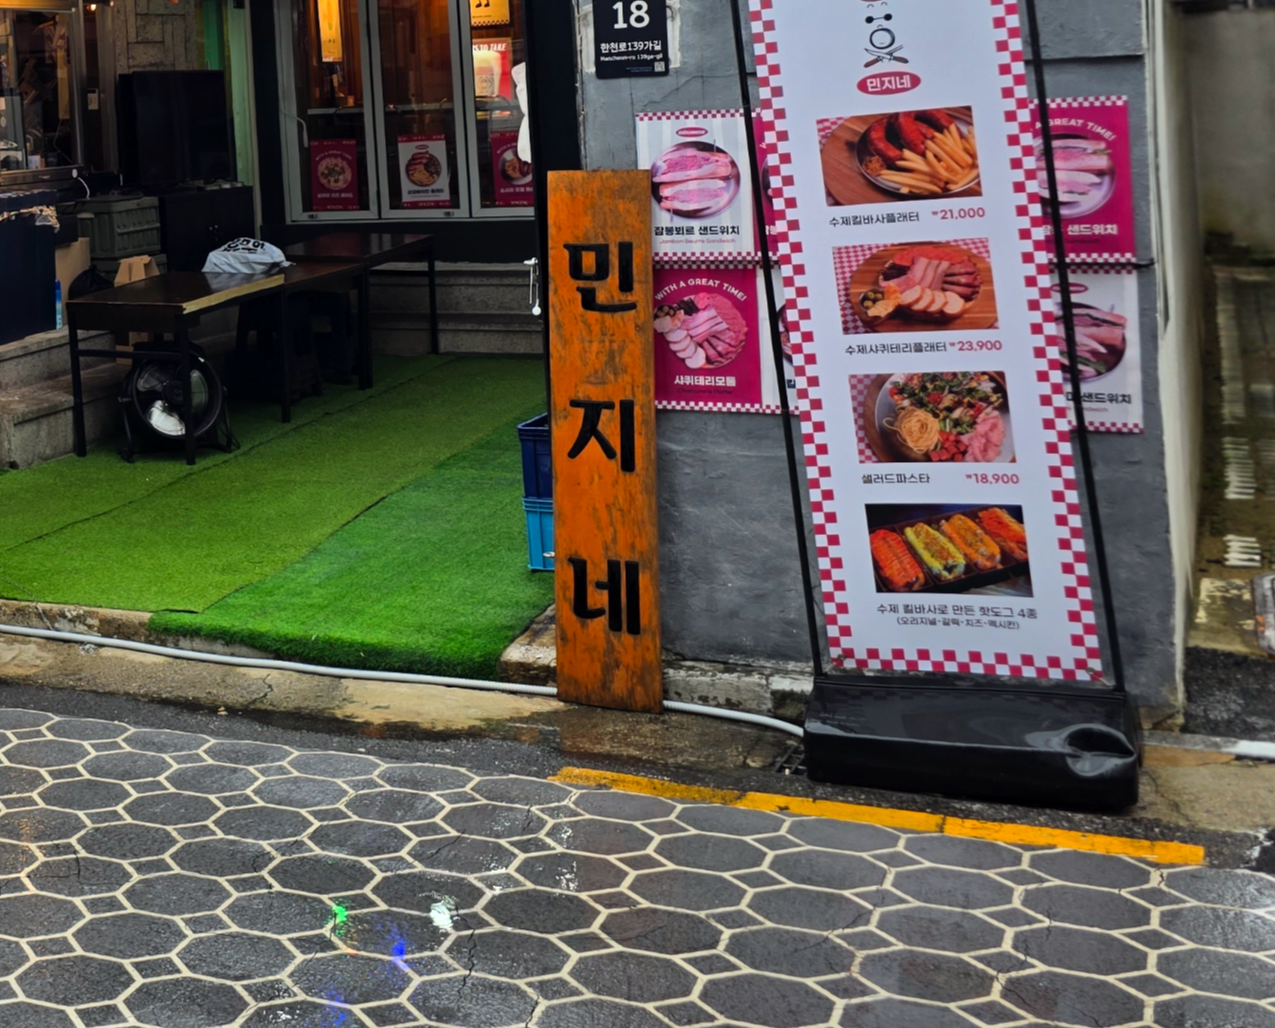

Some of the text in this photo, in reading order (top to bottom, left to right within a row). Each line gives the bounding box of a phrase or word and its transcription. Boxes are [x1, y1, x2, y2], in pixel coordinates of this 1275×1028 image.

[612, 0, 650, 29] 18
[489, 43, 507, 51] TAKE
[600, 40, 662, 54] 한천로139가길
[866, 75, 912, 92] 민지네
[1086, 122, 1116, 141] TIME!
[829, 211, 920, 227] 수제킬바사플래터
[654, 225, 740, 236] 잠봉뵈르 샌드위치
[1067, 224, 1118, 236] 샌드위치
[655, 278, 747, 302] WITH A GREAT TIME!
[845, 342, 947, 355] 수제샤퀴테리플래터
[1081, 392, 1132, 404] 샌드위치
[563, 241, 642, 637] 민지네
[861, 473, 930, 485] 샐러드파스타
[877, 603, 1038, 620] 수제 킬바사로 만든 핫도그 4종
